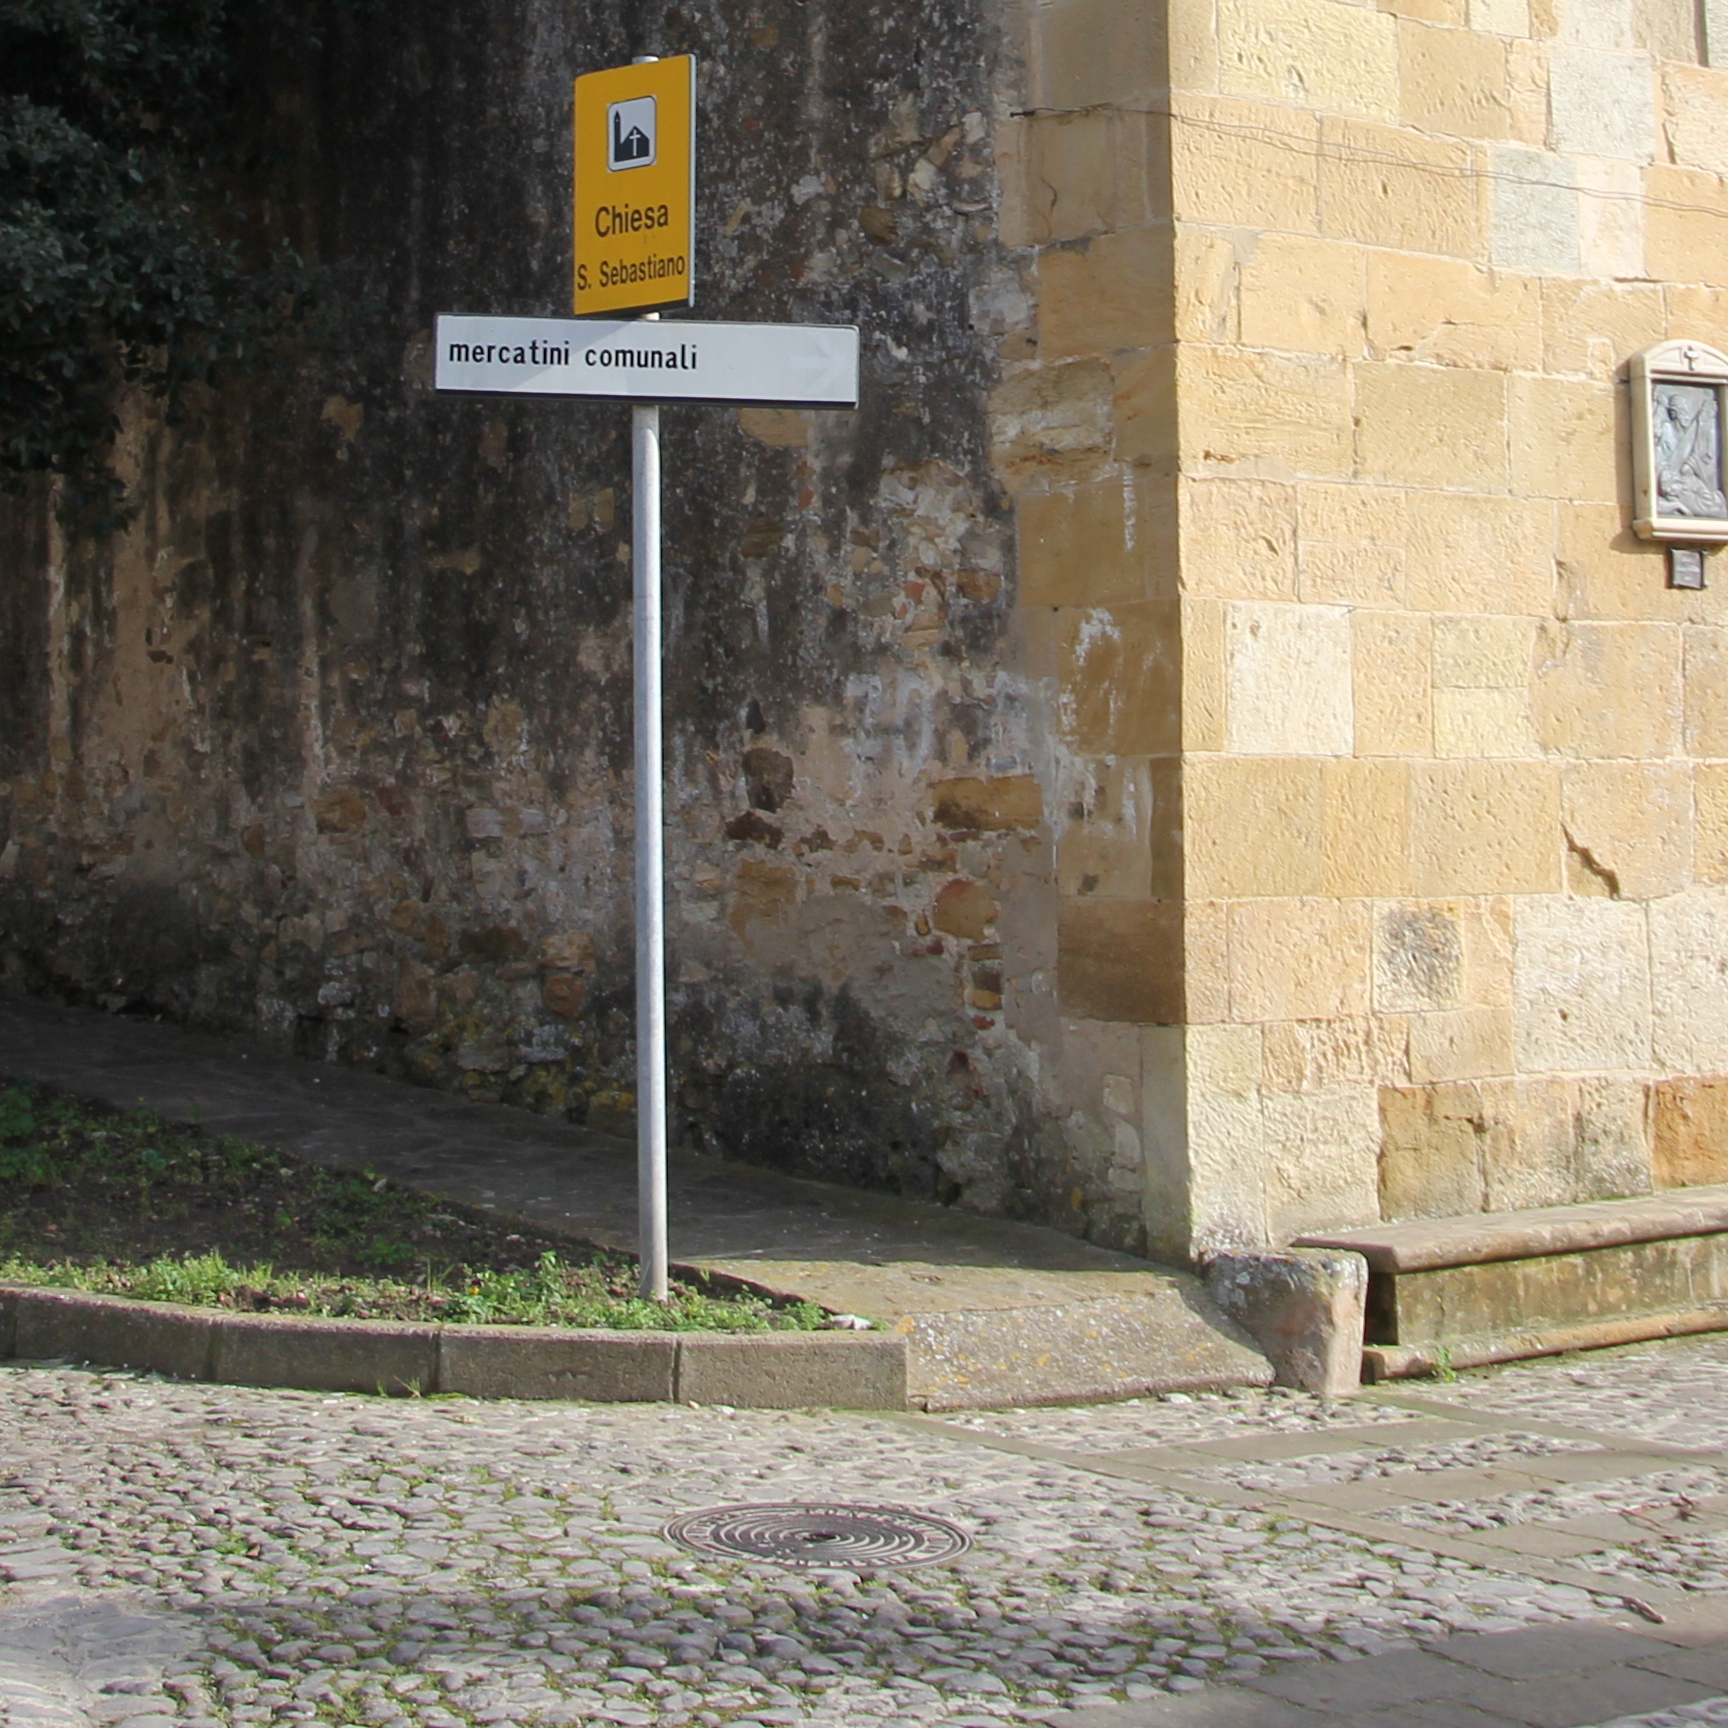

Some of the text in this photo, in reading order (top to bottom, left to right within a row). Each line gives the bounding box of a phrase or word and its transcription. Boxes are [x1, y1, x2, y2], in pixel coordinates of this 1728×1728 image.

[594, 203, 669, 238] Chiesa
[576, 253, 685, 291] S. Sebastiano
[448, 338, 698, 370] mercatini comunali
